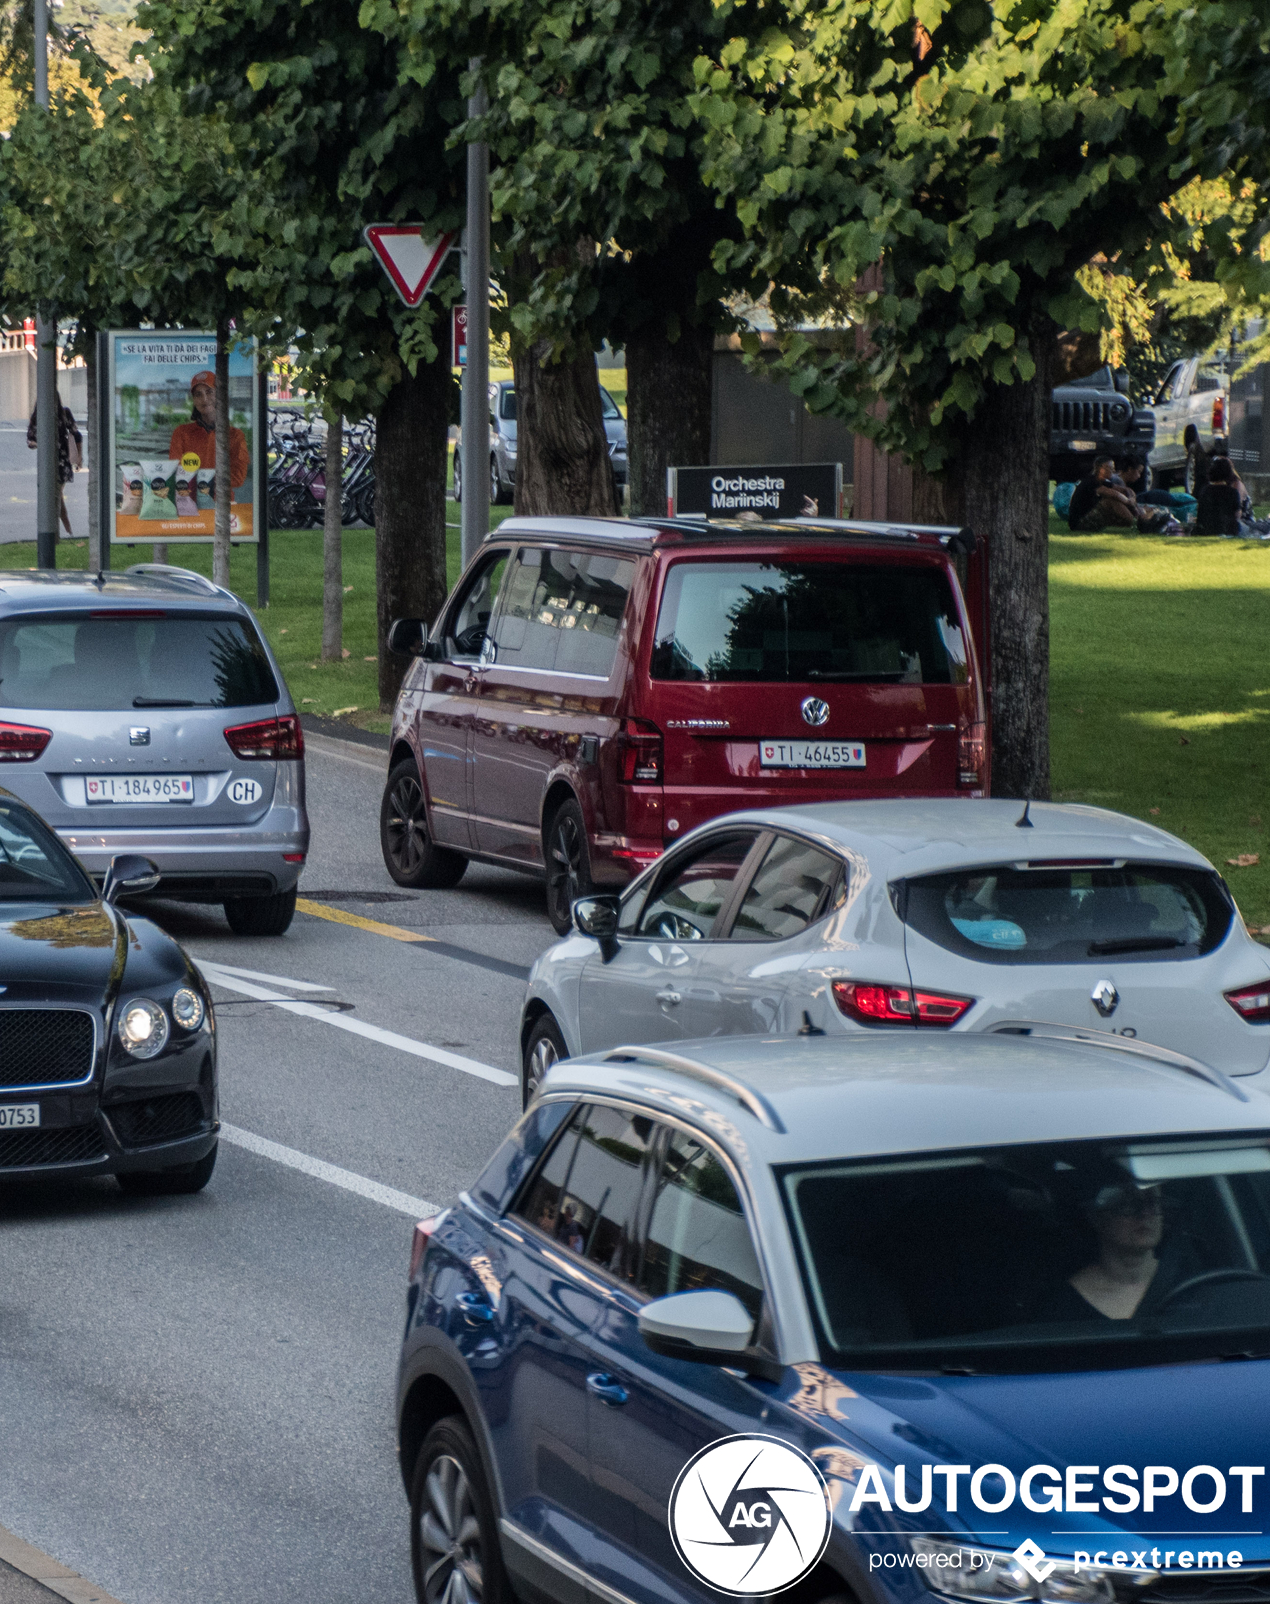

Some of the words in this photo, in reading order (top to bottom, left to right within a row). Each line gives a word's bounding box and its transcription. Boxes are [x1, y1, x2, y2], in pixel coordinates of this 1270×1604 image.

[137, 344, 147, 353] LA
[149, 344, 164, 353] VITA
[166, 344, 173, 353] TI
[186, 344, 198, 353] DEI
[144, 355, 156, 363] FAI
[157, 354, 178, 363] DELLE
[711, 475, 785, 492] Orchestra
[711, 492, 780, 509] Mariinskij
[233, 782, 255, 801] CH
